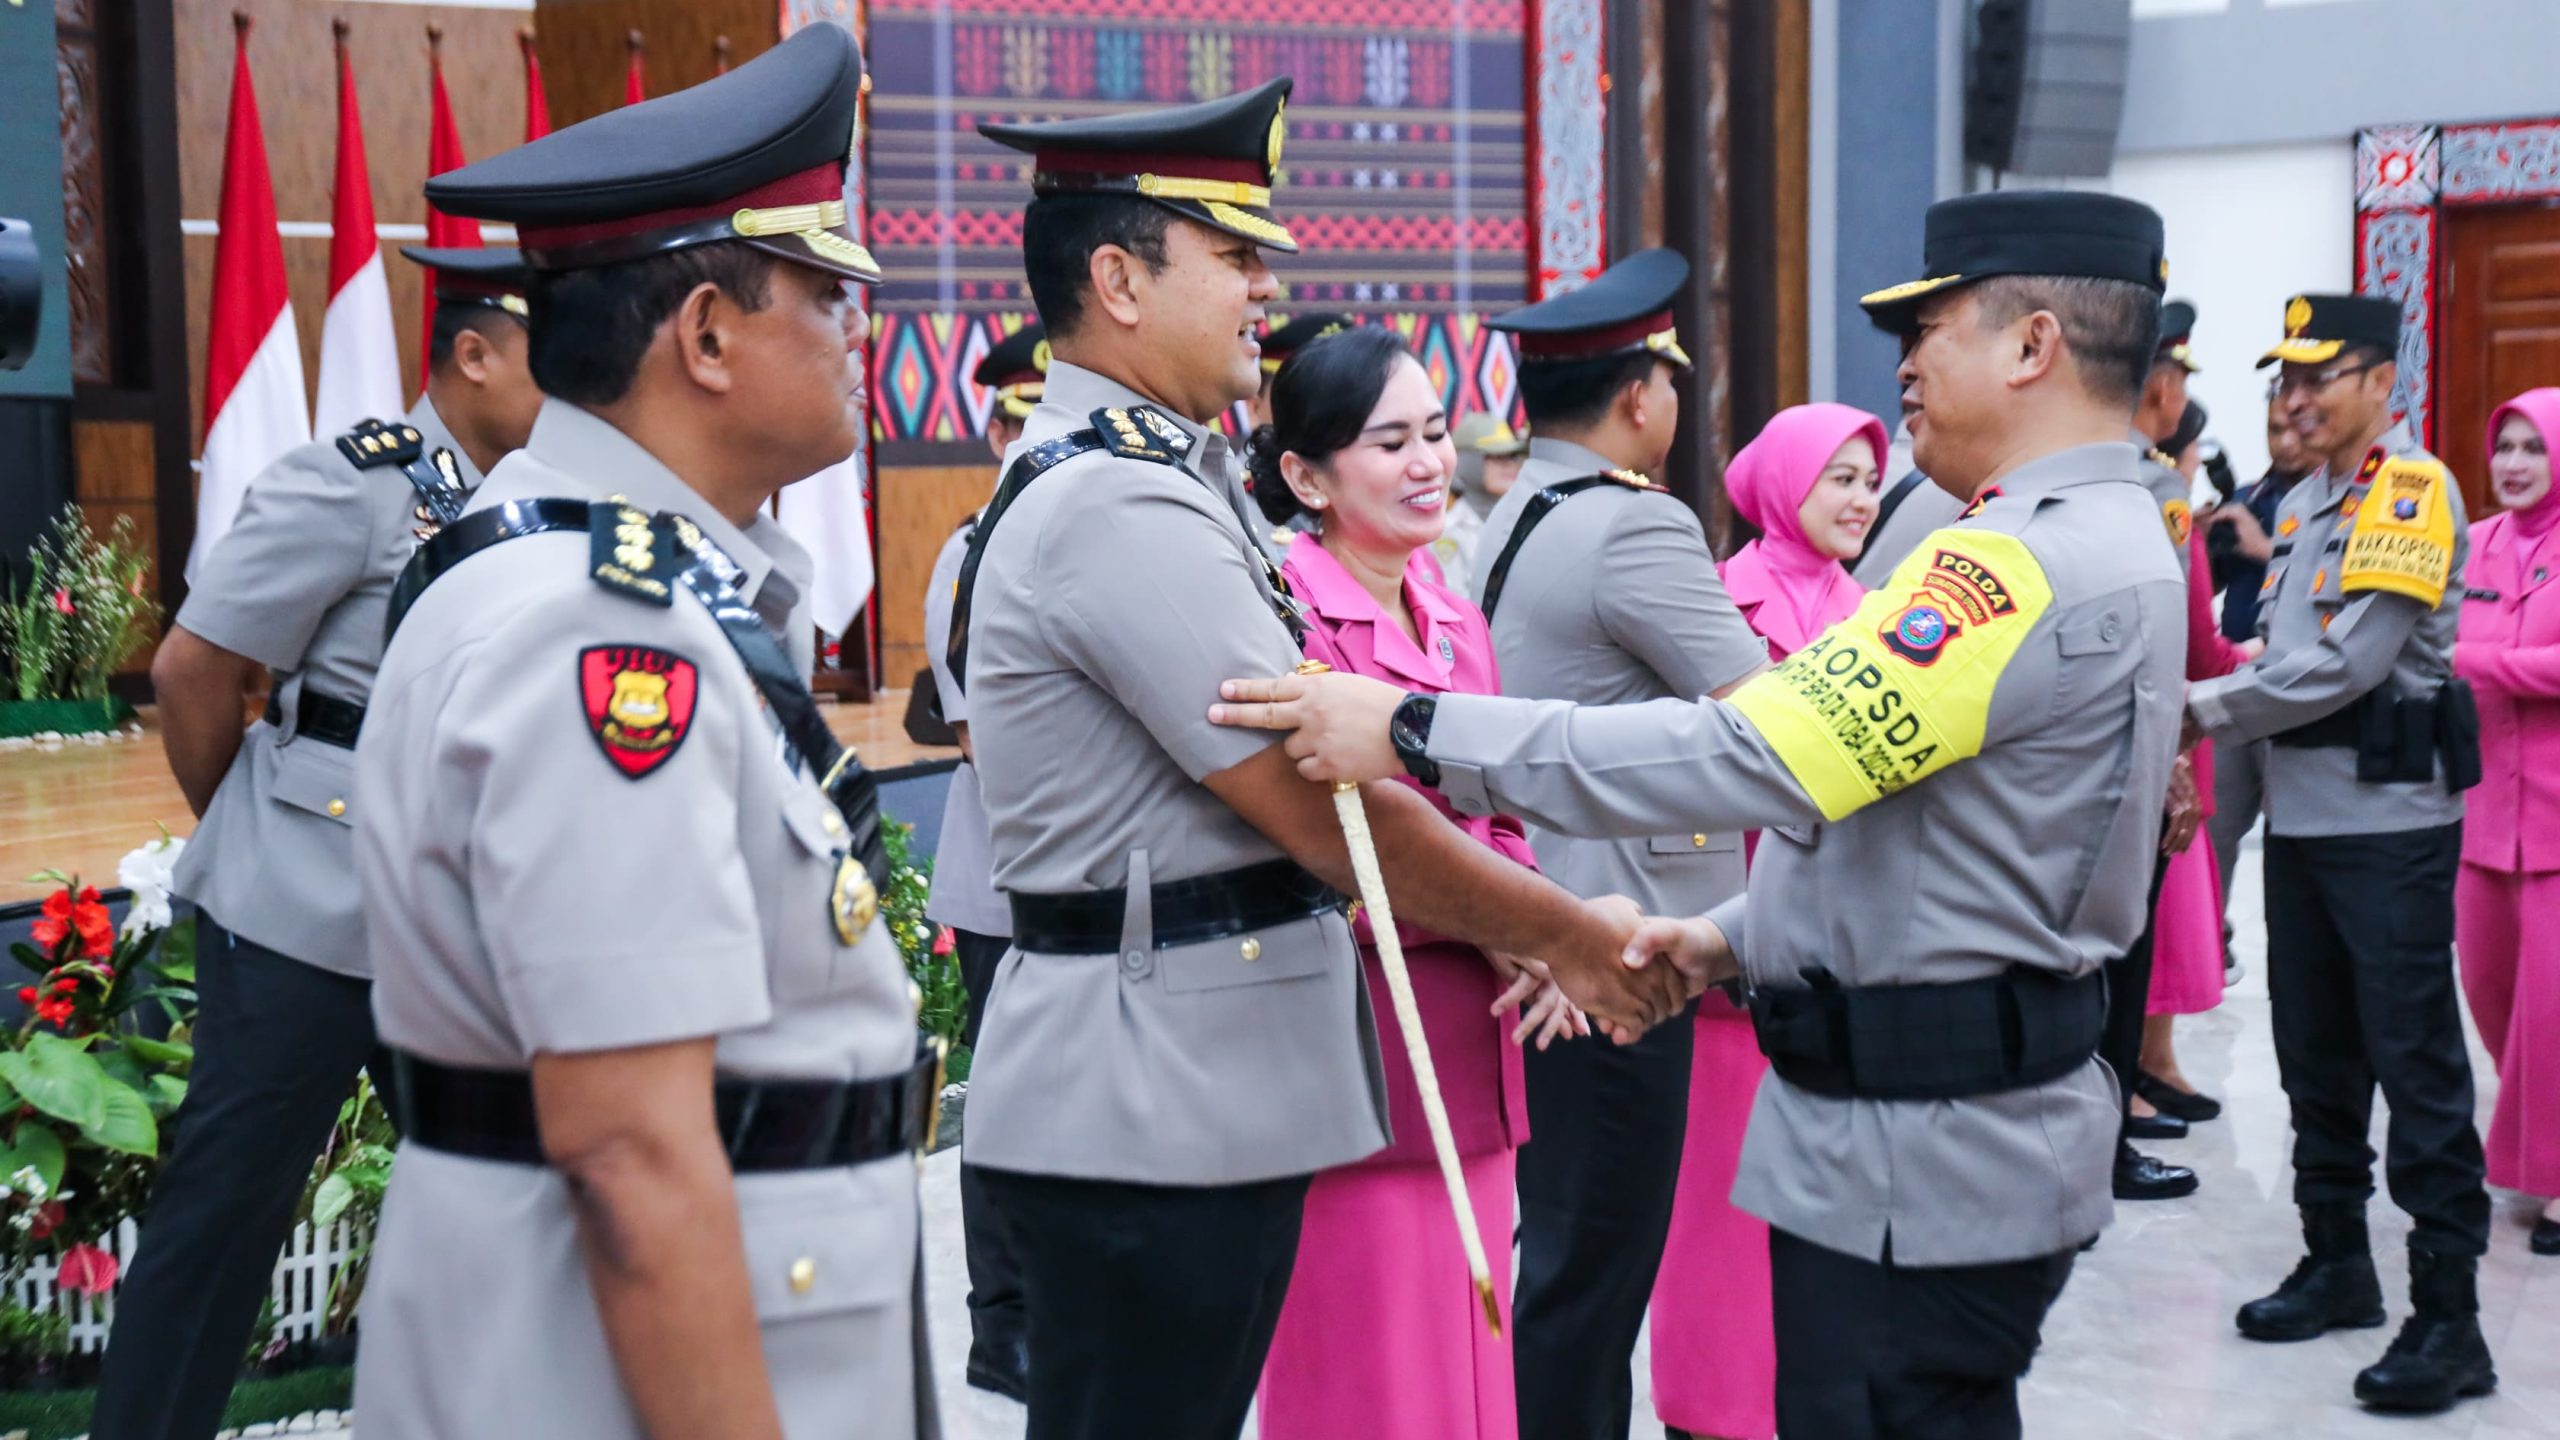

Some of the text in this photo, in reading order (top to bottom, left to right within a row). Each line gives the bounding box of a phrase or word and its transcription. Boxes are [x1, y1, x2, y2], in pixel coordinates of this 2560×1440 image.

[1940, 554, 2008, 610] POLDA
[1768, 659, 1817, 686] ANTAP
[1799, 676, 1849, 723] BRATA
[1832, 708, 1875, 755] TOBA
[1801, 636, 1938, 774] AOPSDA
